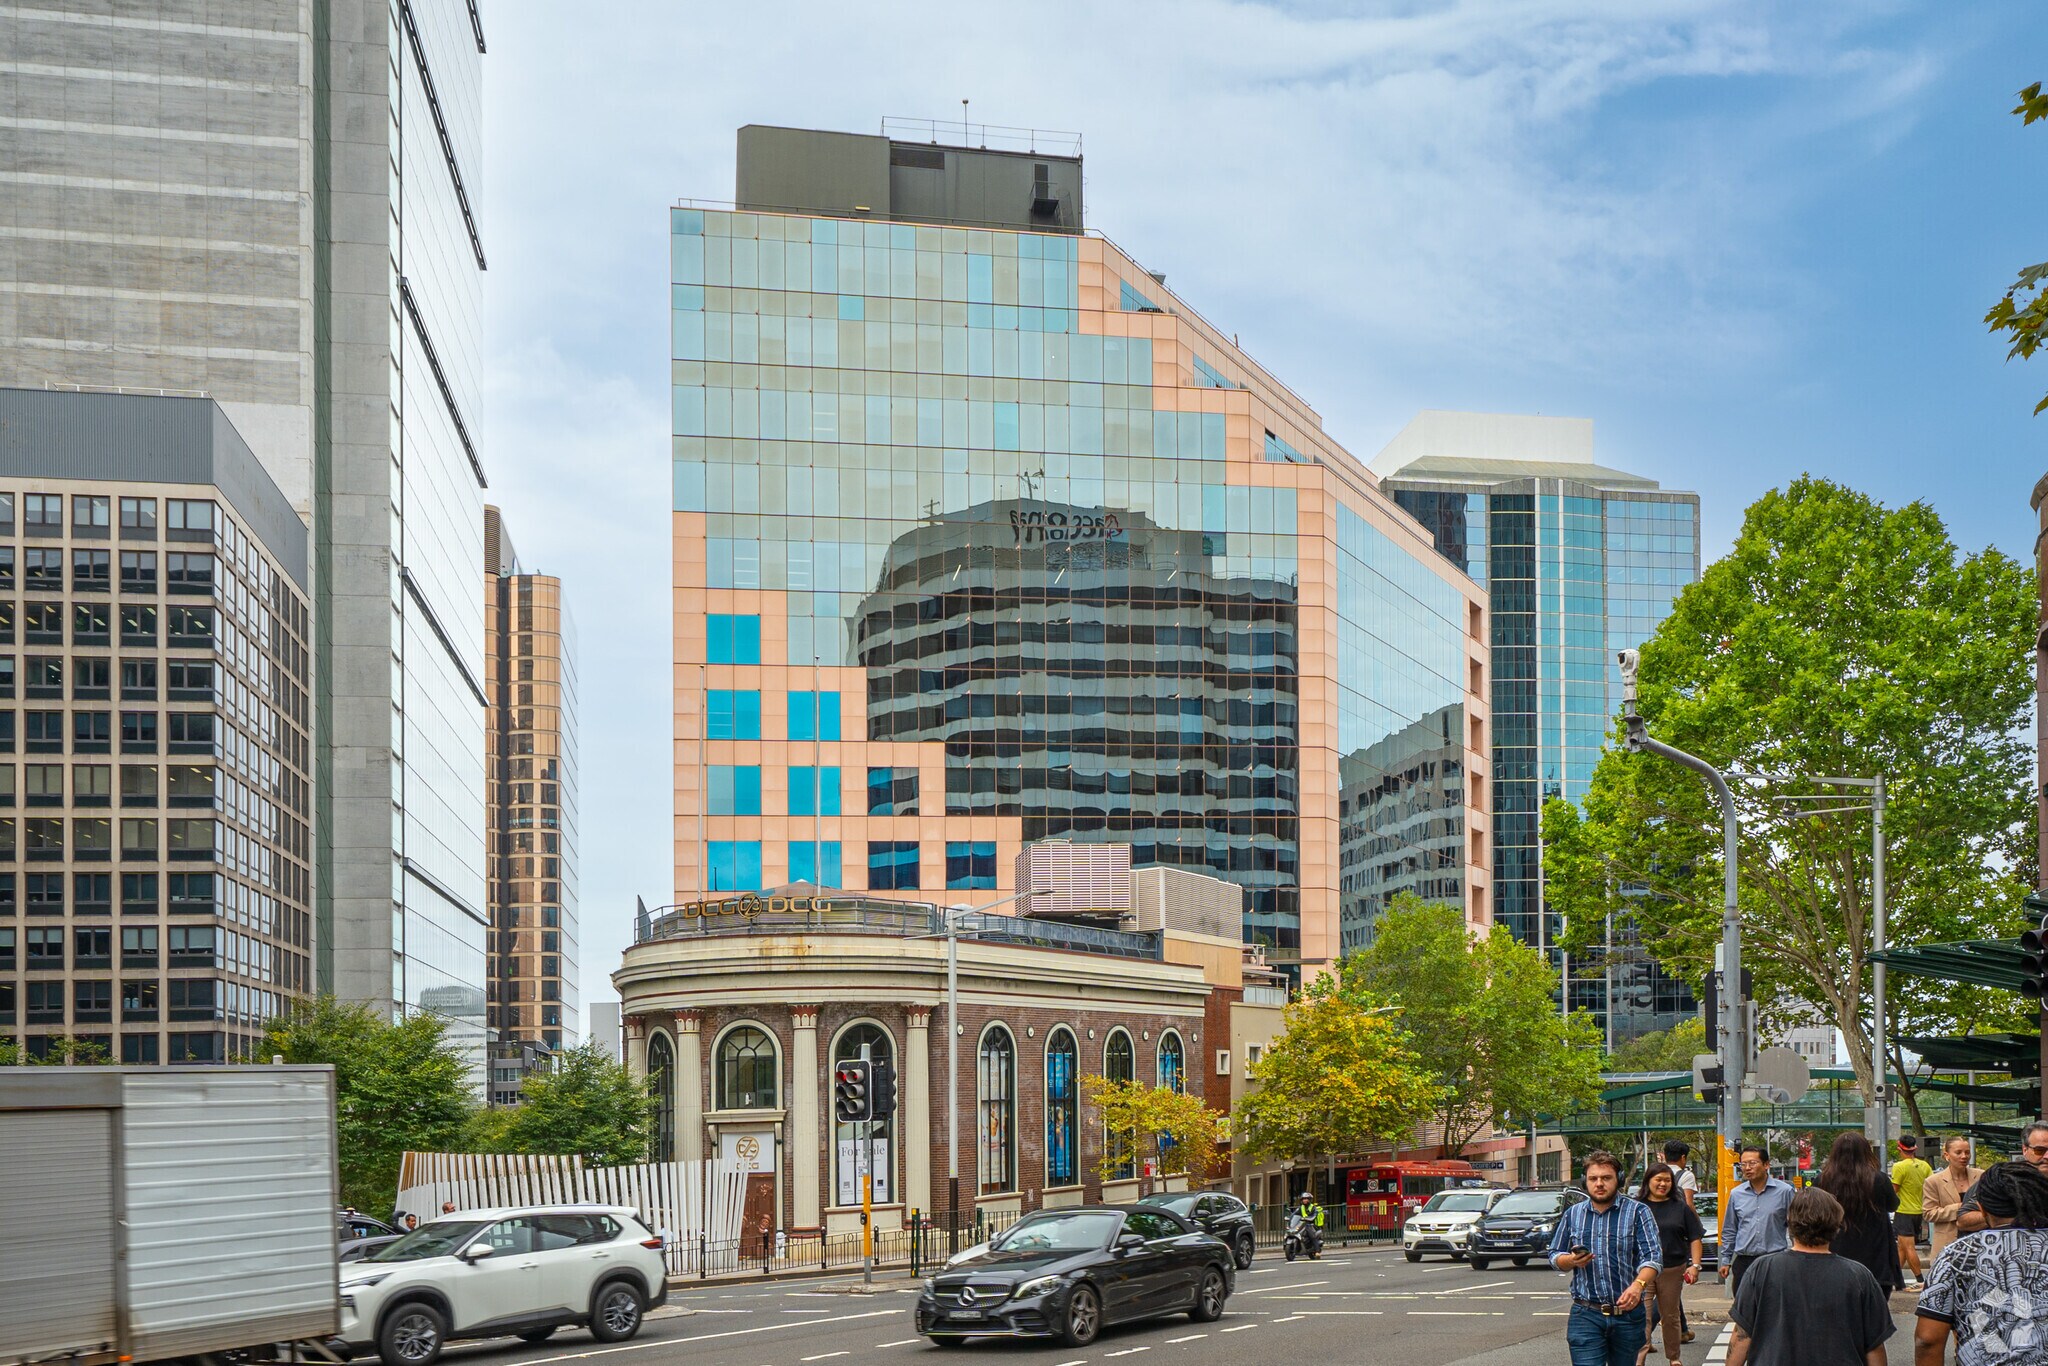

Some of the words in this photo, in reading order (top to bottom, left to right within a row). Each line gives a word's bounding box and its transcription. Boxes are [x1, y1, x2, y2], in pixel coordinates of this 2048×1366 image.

[684, 899, 736, 919] DCG
[768, 896, 832, 913] DCG
[841, 1146, 861, 1157] For
